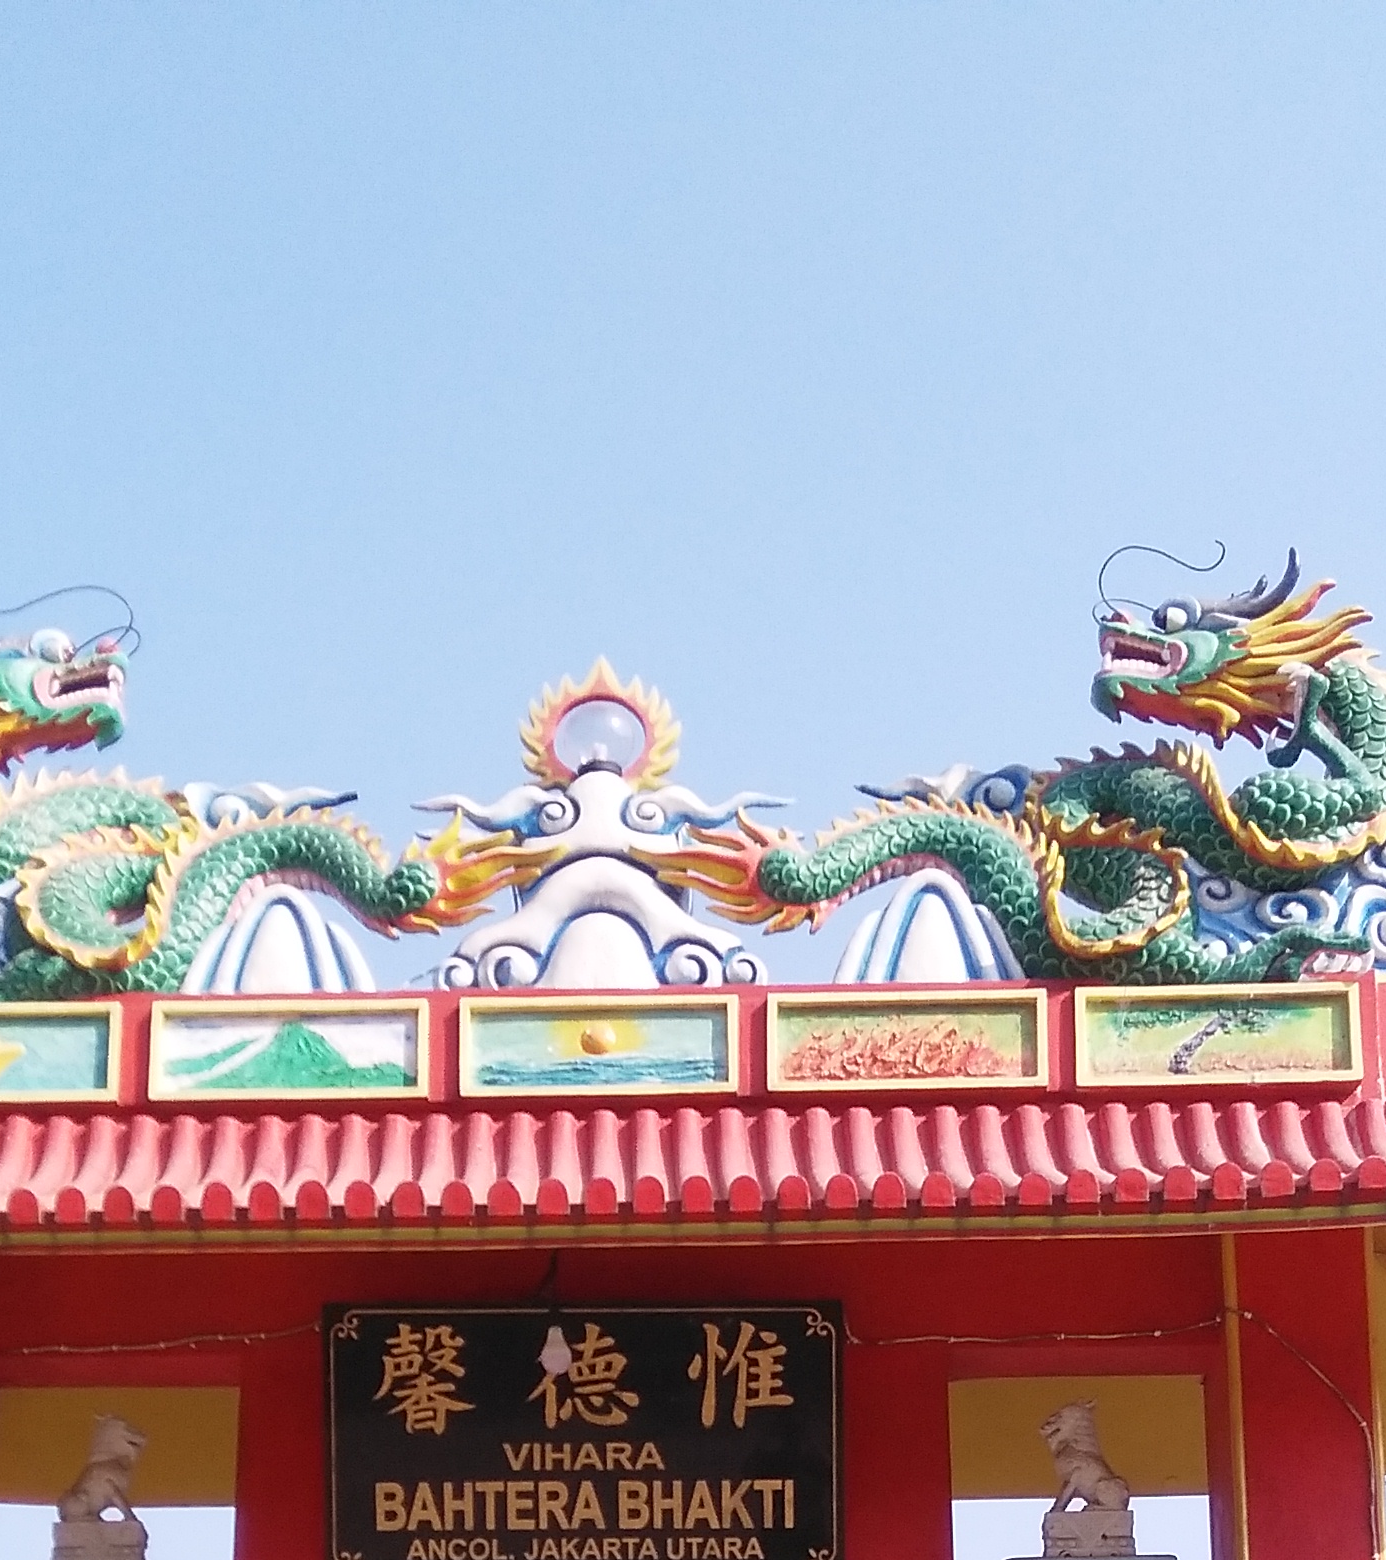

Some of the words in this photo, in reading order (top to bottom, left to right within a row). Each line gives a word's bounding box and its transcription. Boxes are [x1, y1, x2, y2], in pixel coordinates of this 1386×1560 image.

[502, 1442, 665, 1472] VIHARA
[374, 1482, 606, 1532] BAHTERA
[617, 1479, 795, 1530] BHAKTI
[406, 1538, 516, 1560] ANCOL.
[523, 1538, 659, 1560] JAKARTA
[666, 1537, 765, 1560] UTARA
